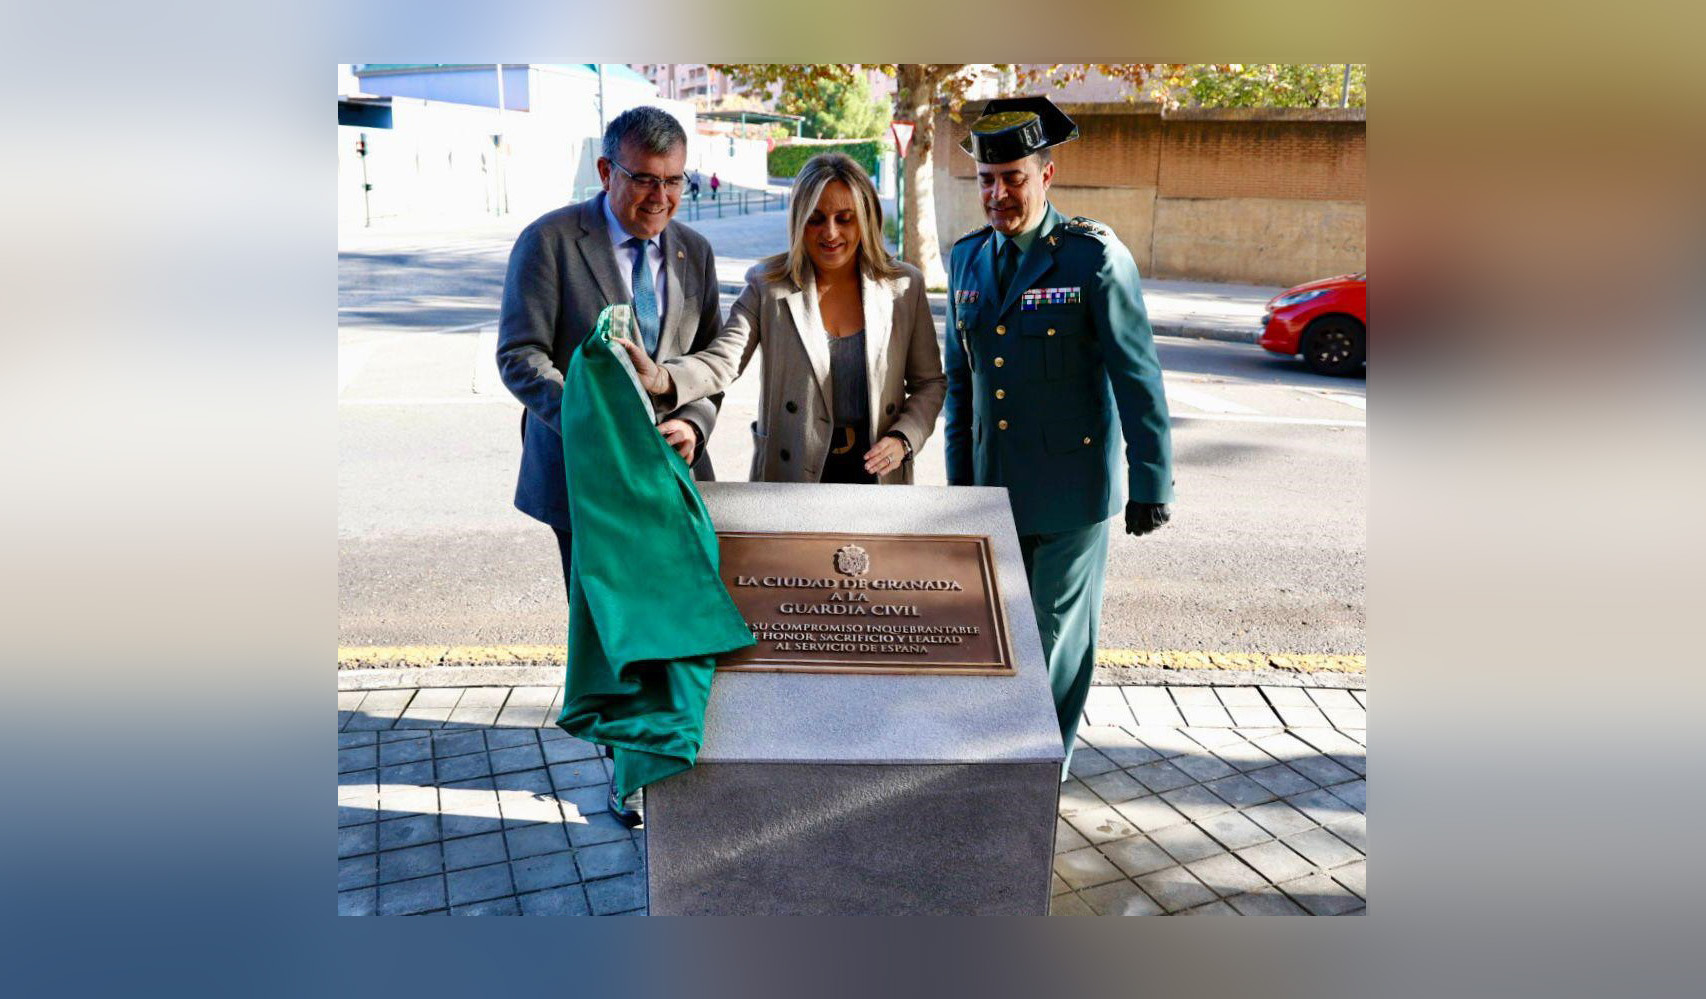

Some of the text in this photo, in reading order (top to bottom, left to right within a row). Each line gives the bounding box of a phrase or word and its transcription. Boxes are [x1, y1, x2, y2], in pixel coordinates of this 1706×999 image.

[738, 575, 963, 592] LA CIUDAD DE GRANADA
[831, 592, 869, 602] A LA
[780, 602, 921, 616] GUARDIA CIVIL
[753, 622, 768, 631] SU
[771, 623, 863, 633] COMPROMISO
[866, 624, 980, 635] INQUEBRANTABLE
[763, 632, 816, 641] HONOR,
[820, 633, 894, 643] SACRIFICIO
[896, 635, 905, 643] Y
[909, 635, 963, 645] LEALTAD
[775, 641, 929, 655] AL SERVICIO DE ESPAÑA
